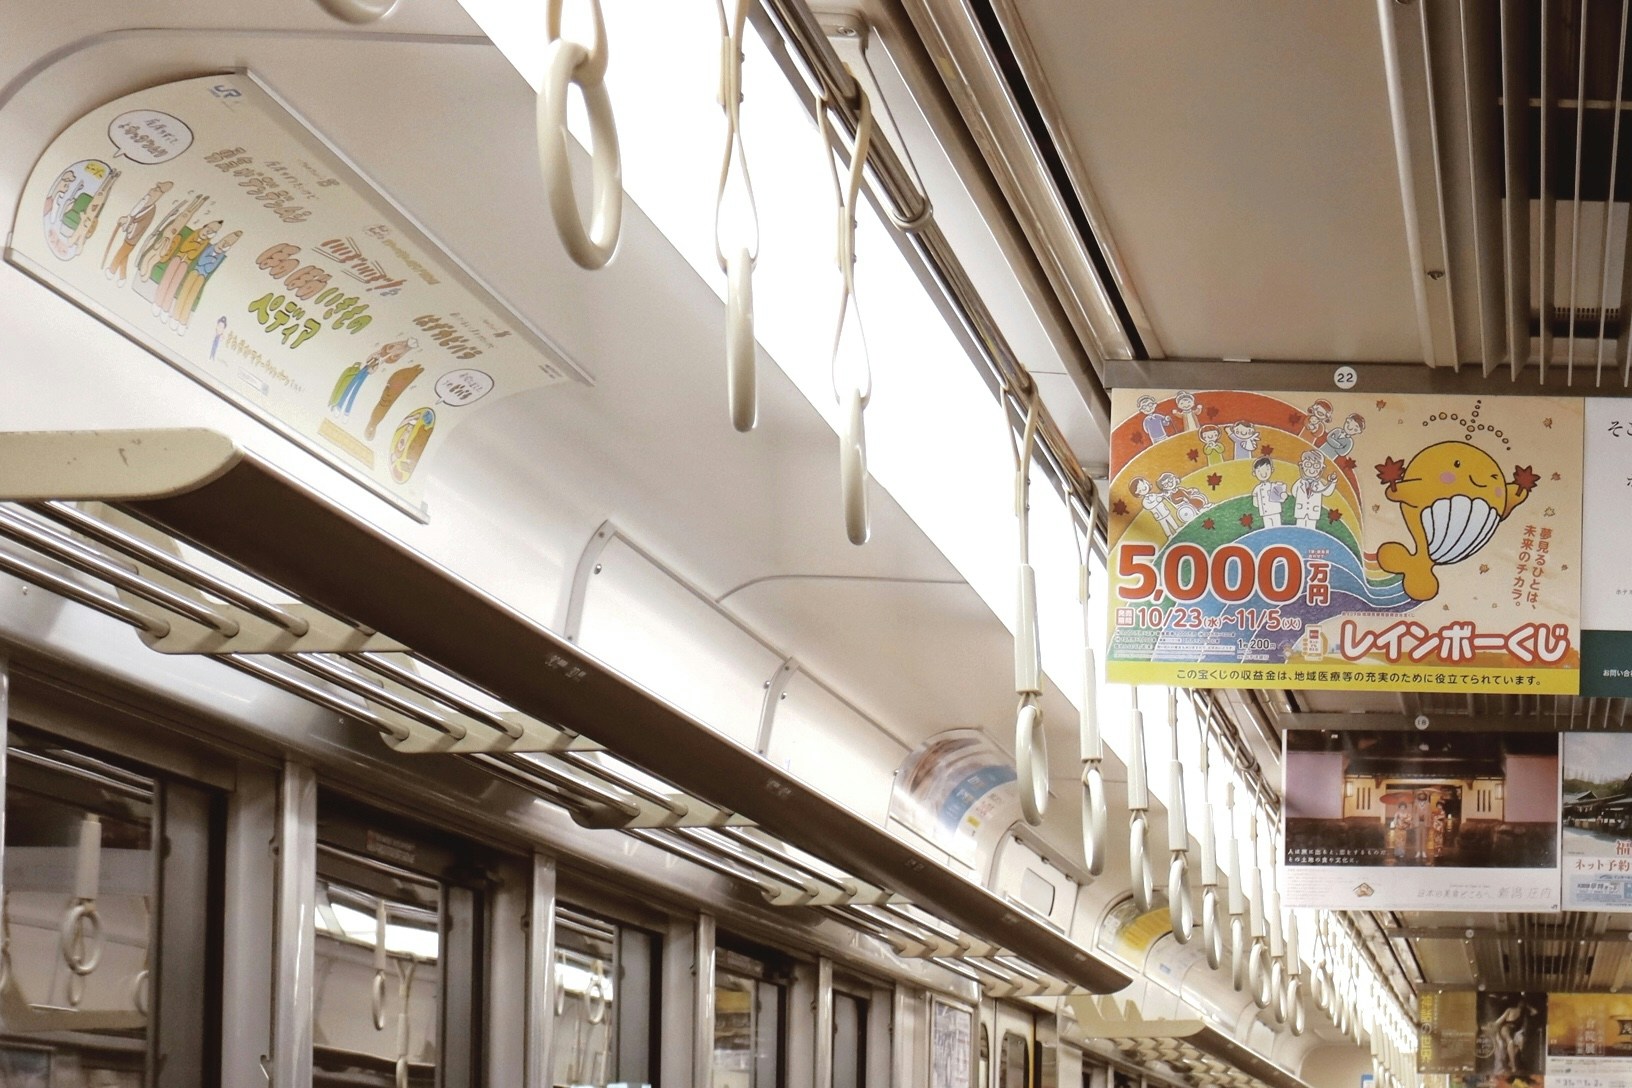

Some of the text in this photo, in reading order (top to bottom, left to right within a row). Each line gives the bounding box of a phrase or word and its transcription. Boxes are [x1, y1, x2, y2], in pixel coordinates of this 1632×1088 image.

[248, 292, 321, 350] ペディア
[1336, 372, 1354, 383] 22
[1118, 544, 1303, 602] 5,000
[1308, 562, 1331, 605] 万円
[1511, 525, 1537, 607] 未来のチカラ。
[1527, 527, 1553, 611] 夢見るひとは、
[1342, 620, 1571, 664] レインボーくじ
